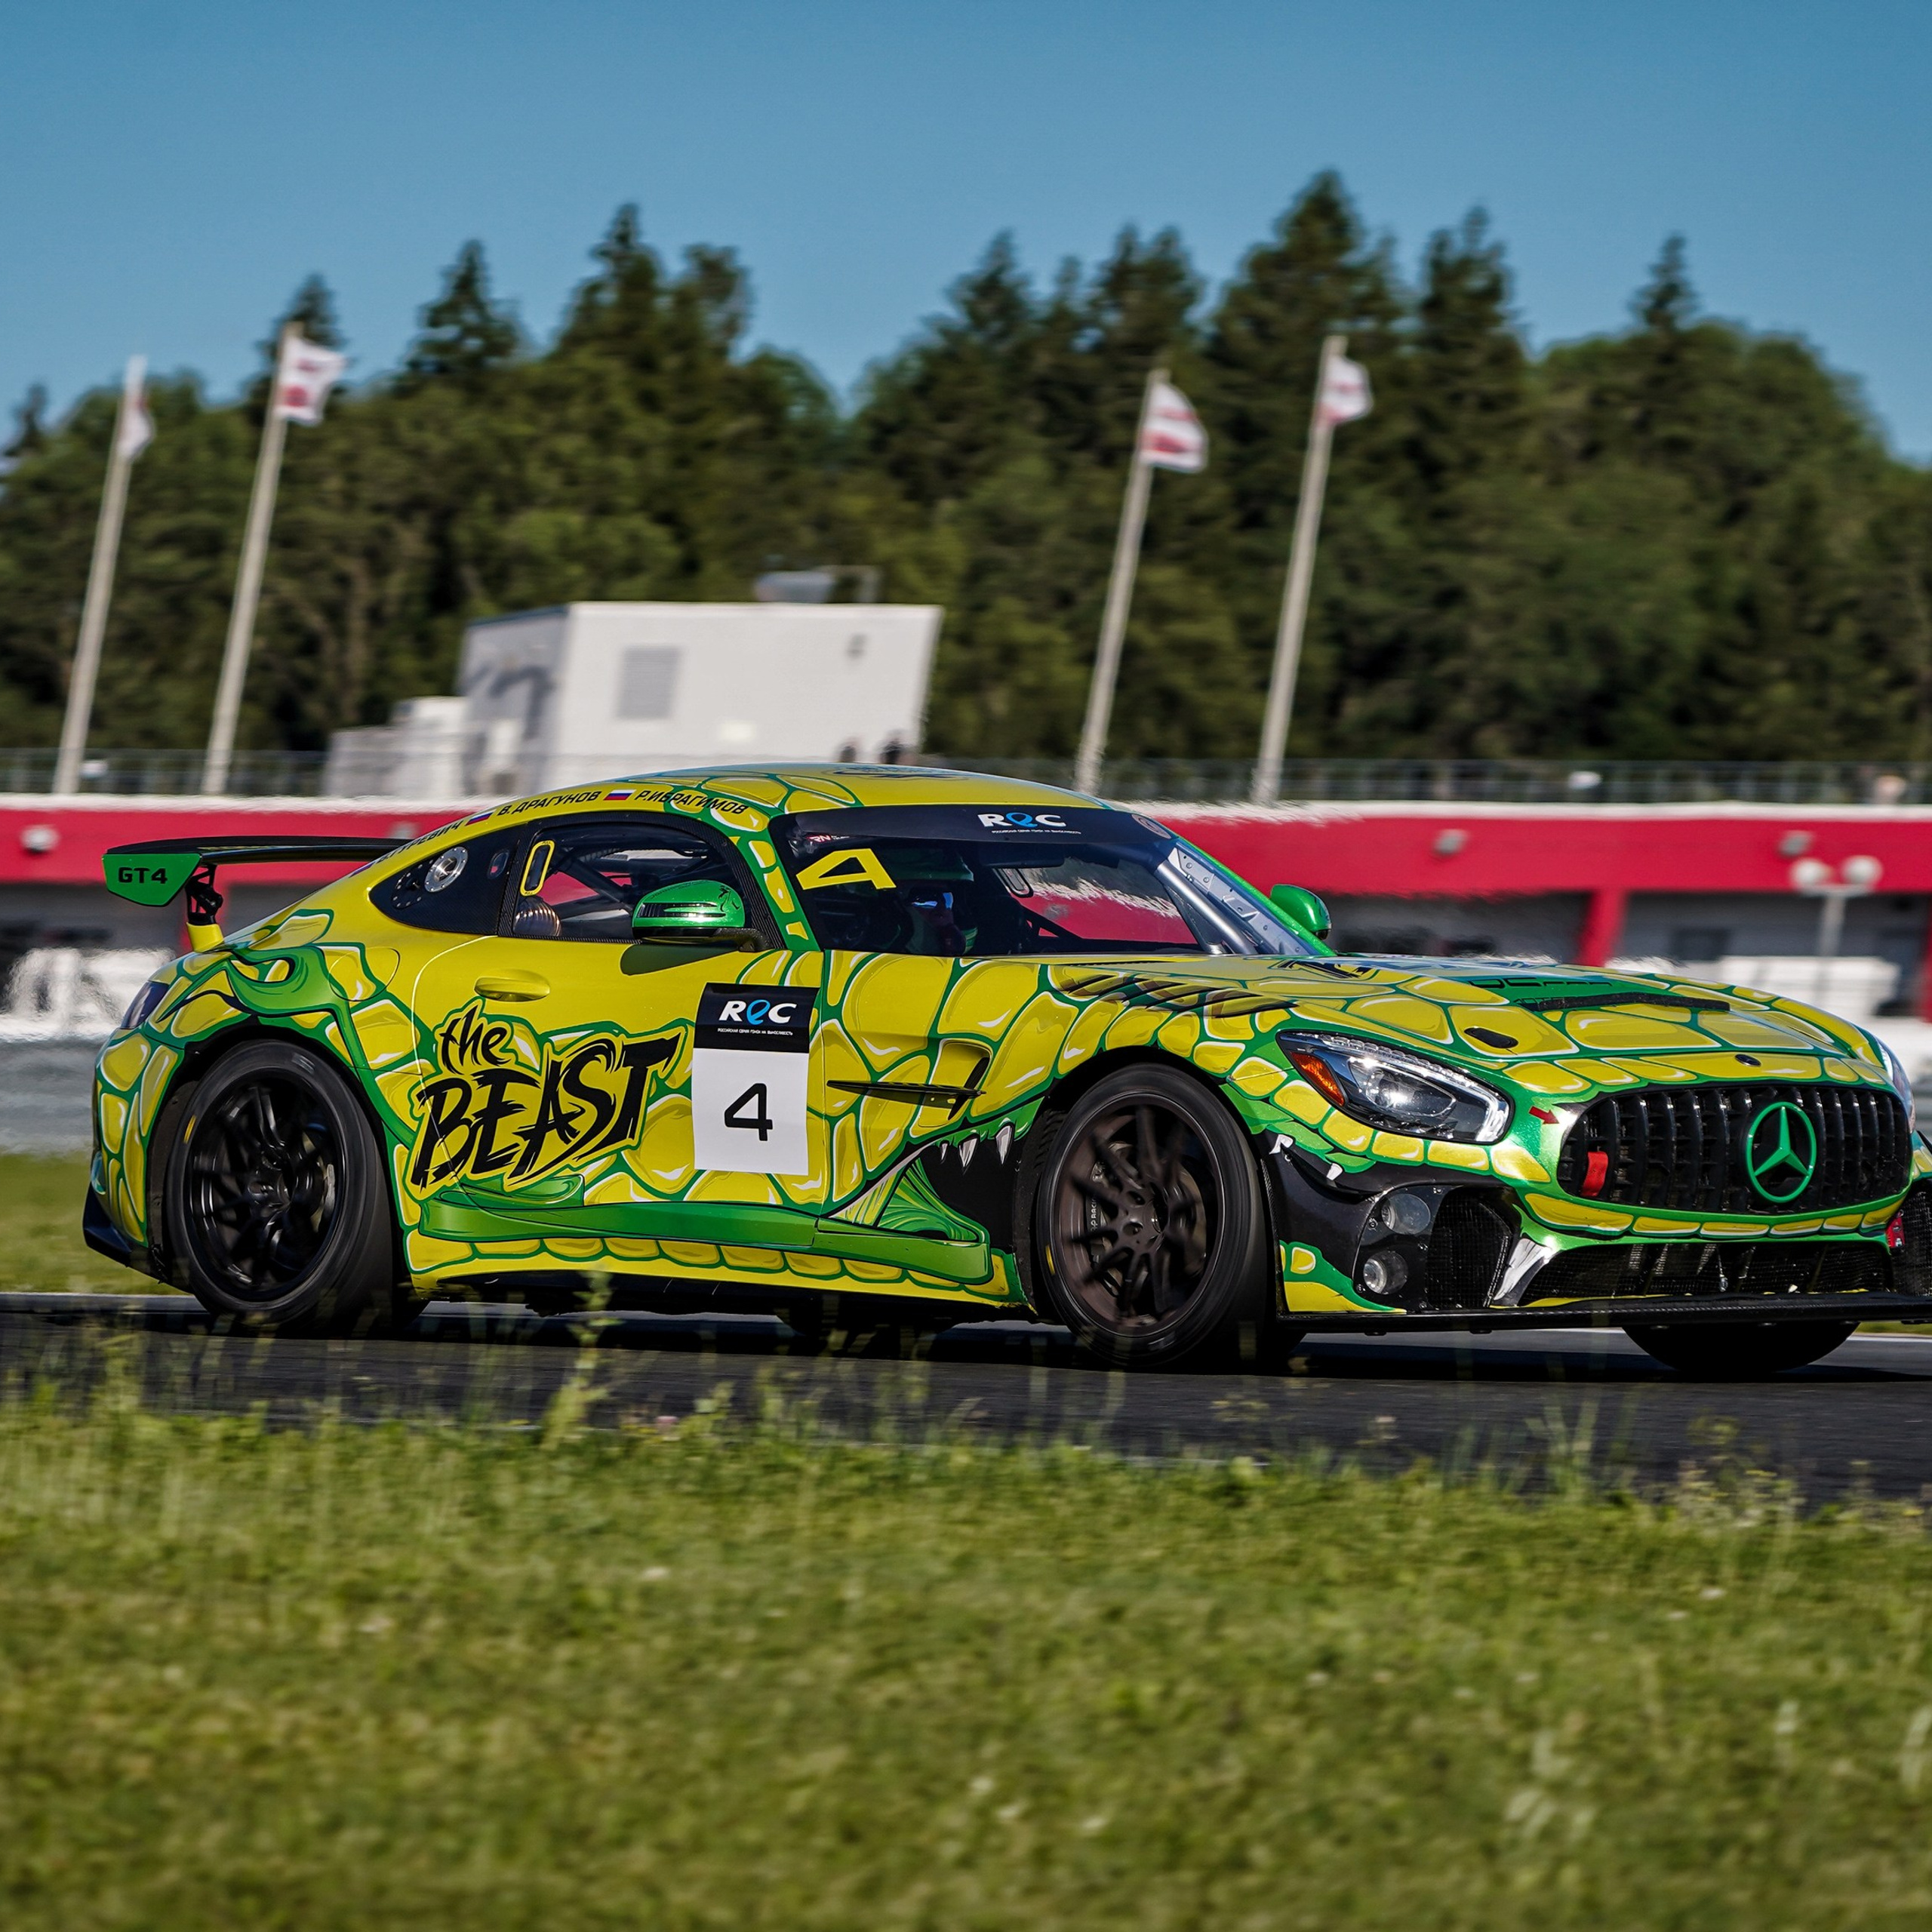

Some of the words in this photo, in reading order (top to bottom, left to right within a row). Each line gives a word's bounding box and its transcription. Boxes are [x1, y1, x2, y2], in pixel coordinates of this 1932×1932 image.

[511, 791, 602, 814] ДРАГУНОВ
[634, 789, 749, 814] Р.ИБРАГИМОВ
[118, 866, 168, 884] GT4
[795, 848, 897, 890] 4
[439, 1005, 512, 1075] the
[411, 1032, 681, 1192] BEAST
[724, 1082, 773, 1141] 4
